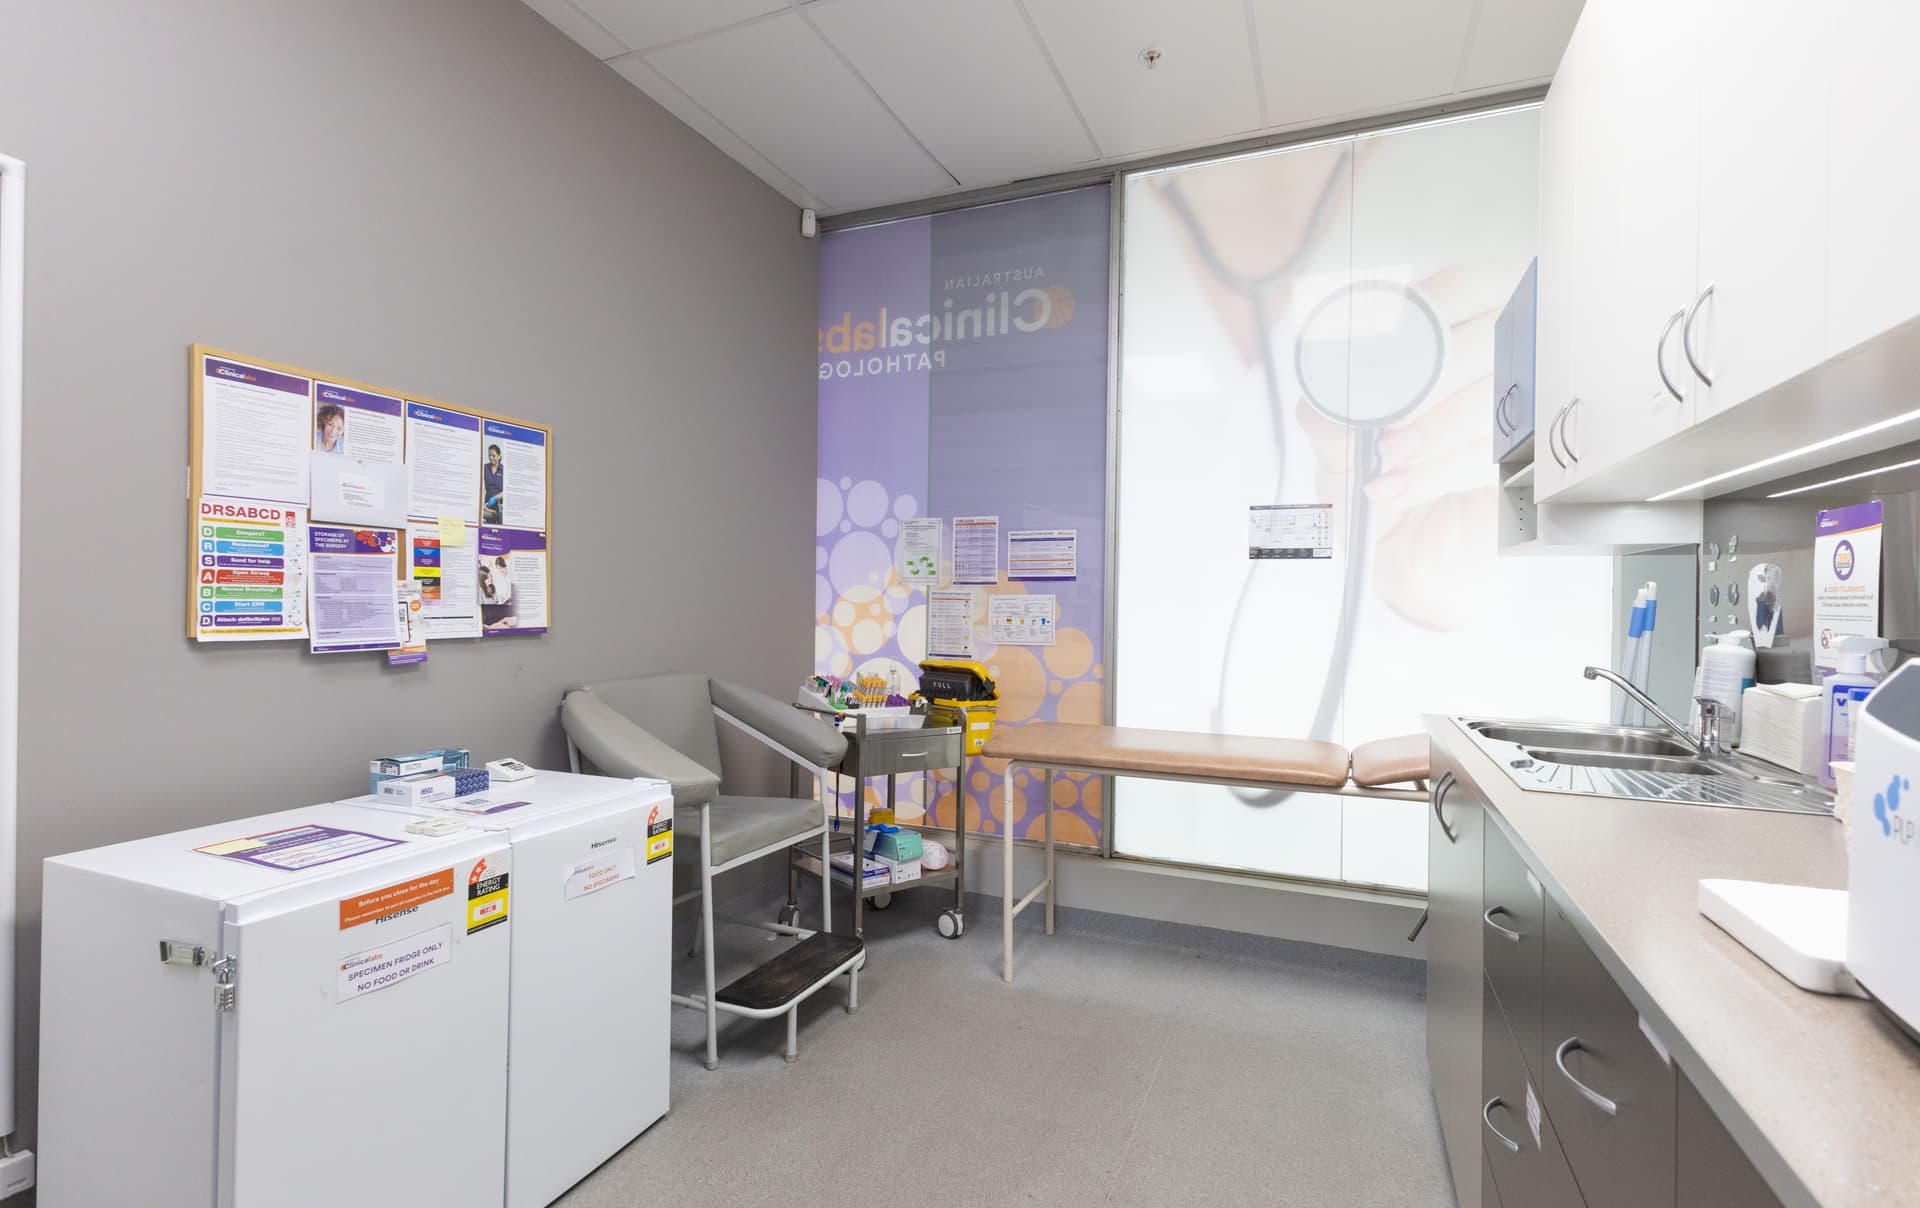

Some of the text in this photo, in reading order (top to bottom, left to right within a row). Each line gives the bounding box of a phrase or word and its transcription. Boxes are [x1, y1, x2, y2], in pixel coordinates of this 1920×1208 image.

[201, 503, 281, 520] DRSABCD
[203, 527, 212, 536] D
[204, 543, 213, 551] R
[204, 556, 213, 565] S
[202, 572, 213, 581] A
[203, 588, 212, 597] B
[202, 602, 211, 611] C
[202, 617, 211, 625] D
[932, 681, 951, 689] FULL
[591, 837, 617, 849] Hisense
[588, 870, 604, 879] FOOD
[476, 877, 501, 890] ENERGY
[358, 878, 440, 907] Before you close for the day
[476, 885, 501, 897] RATING
[583, 884, 593, 893] NO
[343, 953, 384, 971] Clinicalabs
[347, 942, 444, 982] SPECIMEN FRIDGE ONLY
[357, 957, 435, 993] NO FOOD OR DRINK
